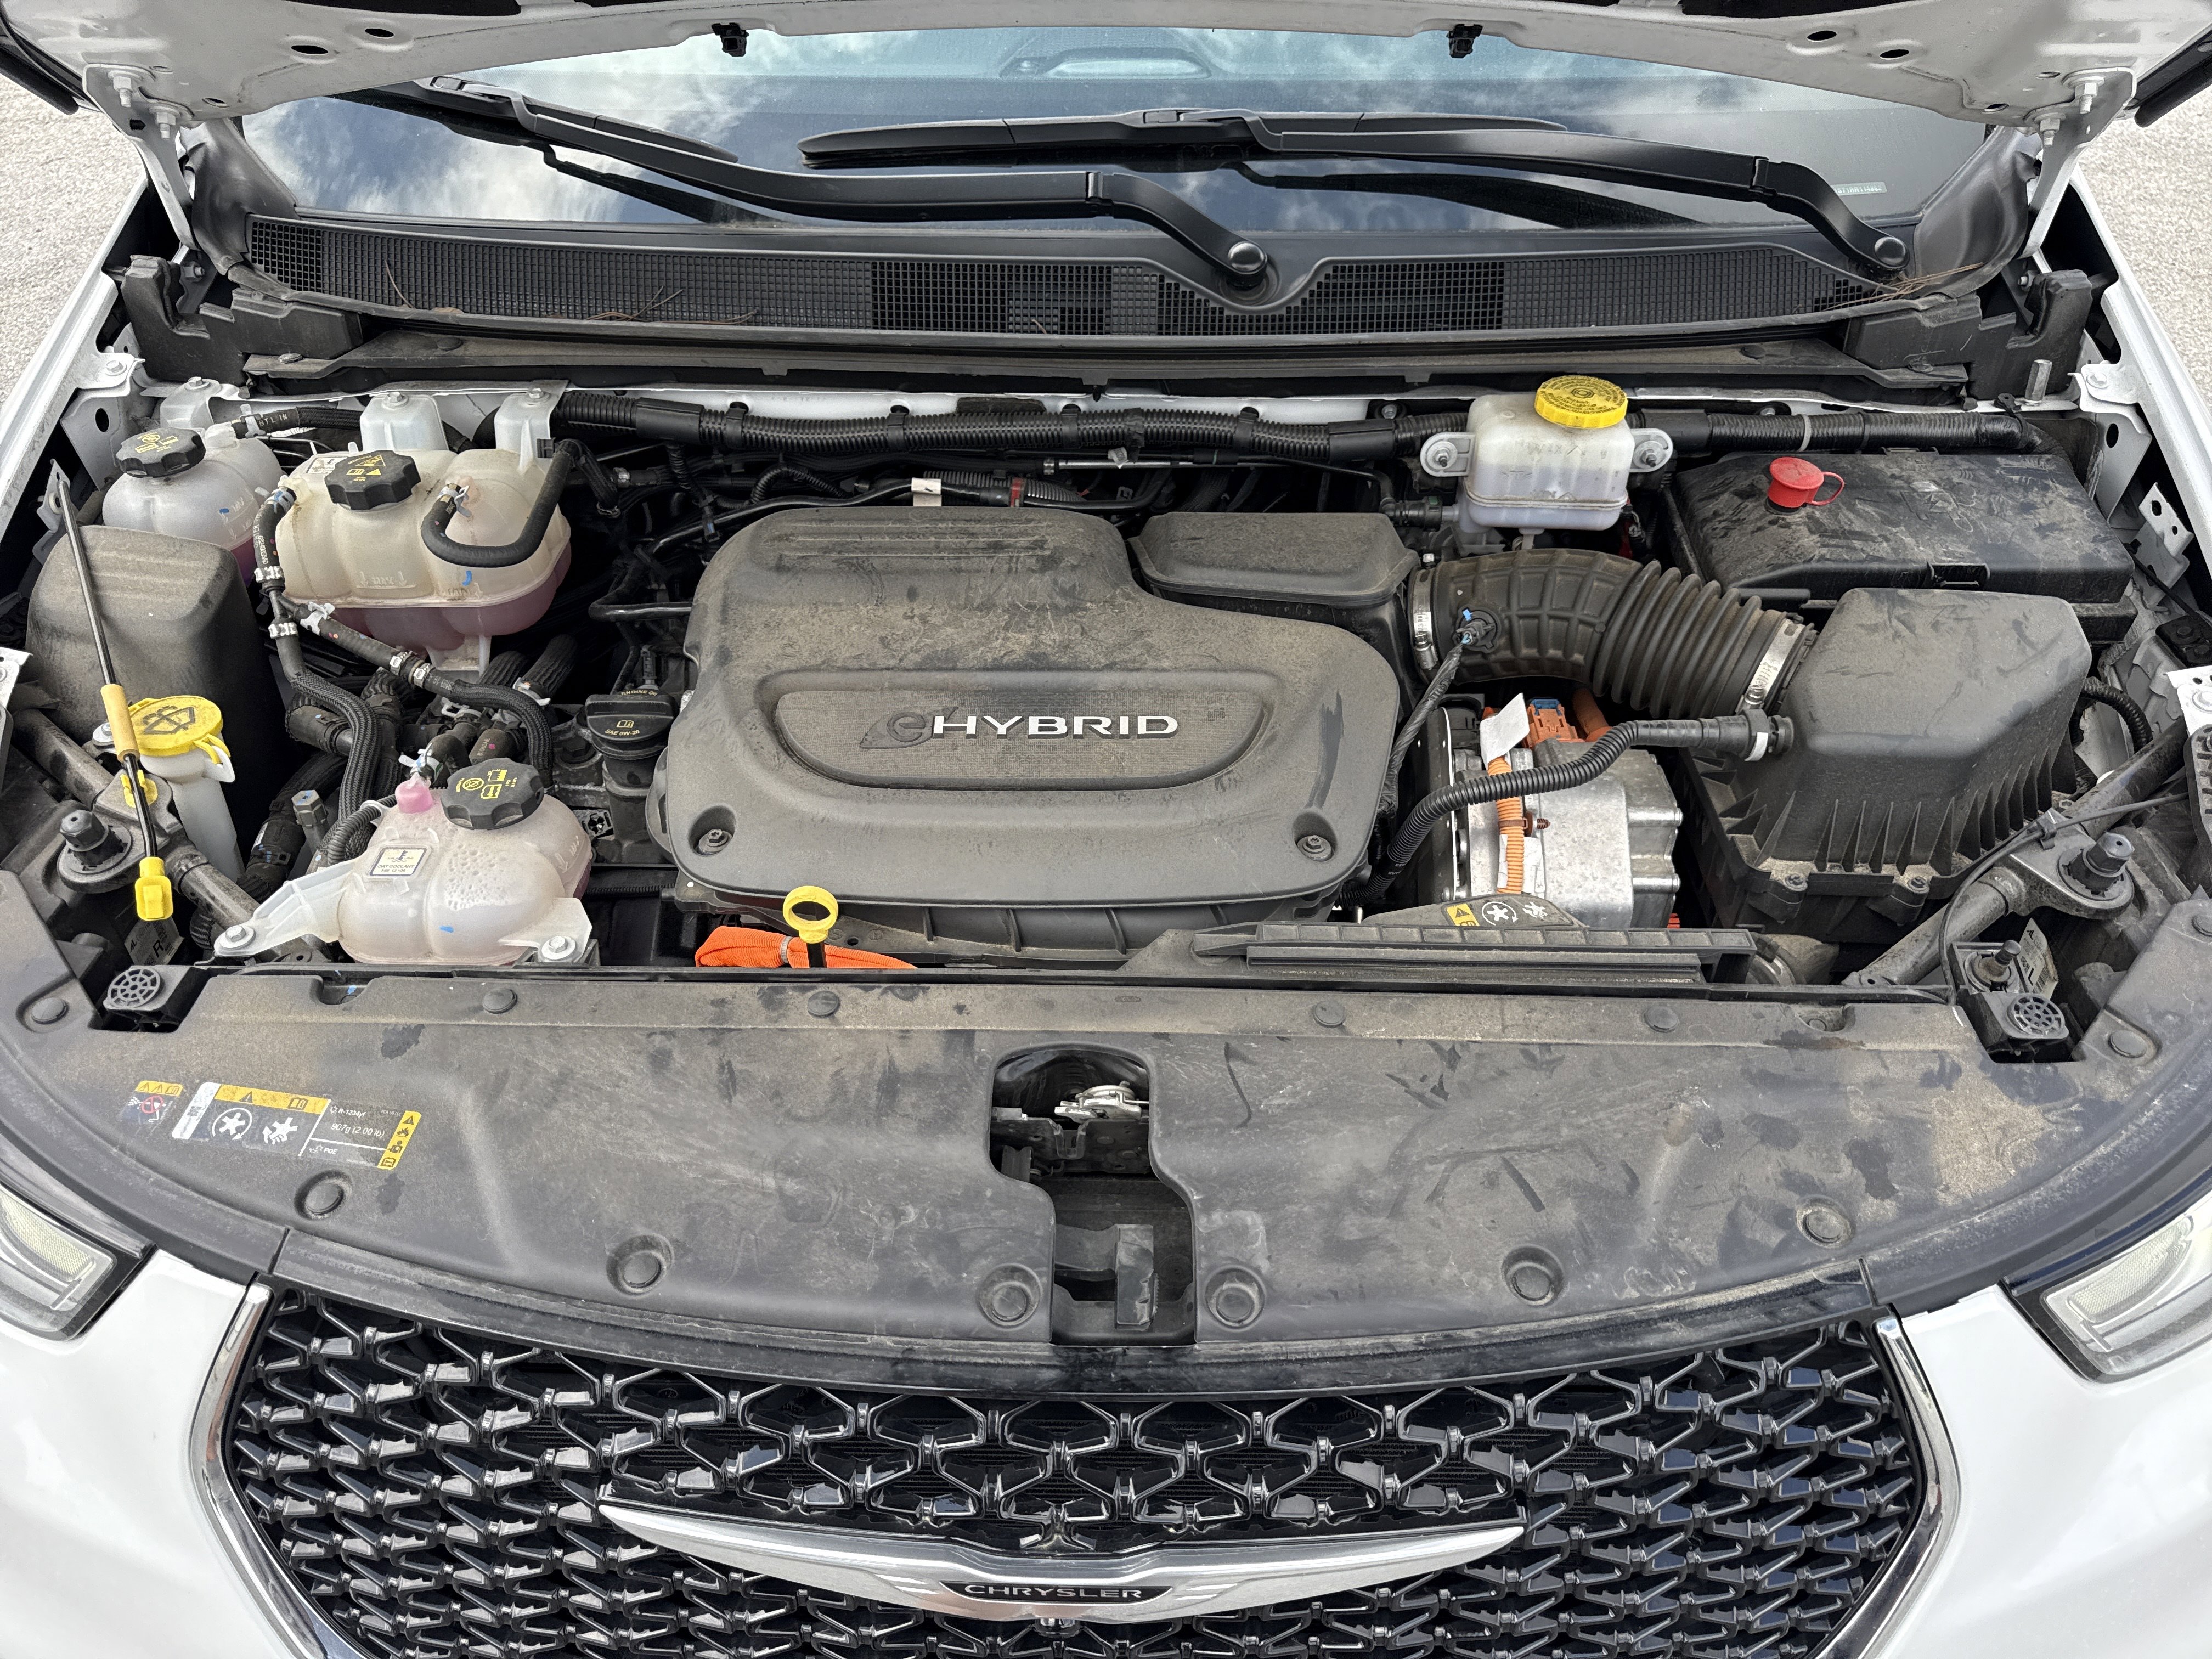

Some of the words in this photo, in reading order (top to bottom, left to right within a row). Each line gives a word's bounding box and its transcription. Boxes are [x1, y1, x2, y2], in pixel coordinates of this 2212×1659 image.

[153, 940, 164, 958] R
[2028, 967, 2034, 986] L
[338, 1108, 367, 1119] R-1234yf
[331, 1122, 351, 1134] 907g
[352, 1126, 374, 1136] (2.00
[374, 1128, 385, 1138] lb)
[323, 1146, 338, 1155] POE
[964, 1585, 1142, 1598] CHRYSLER
